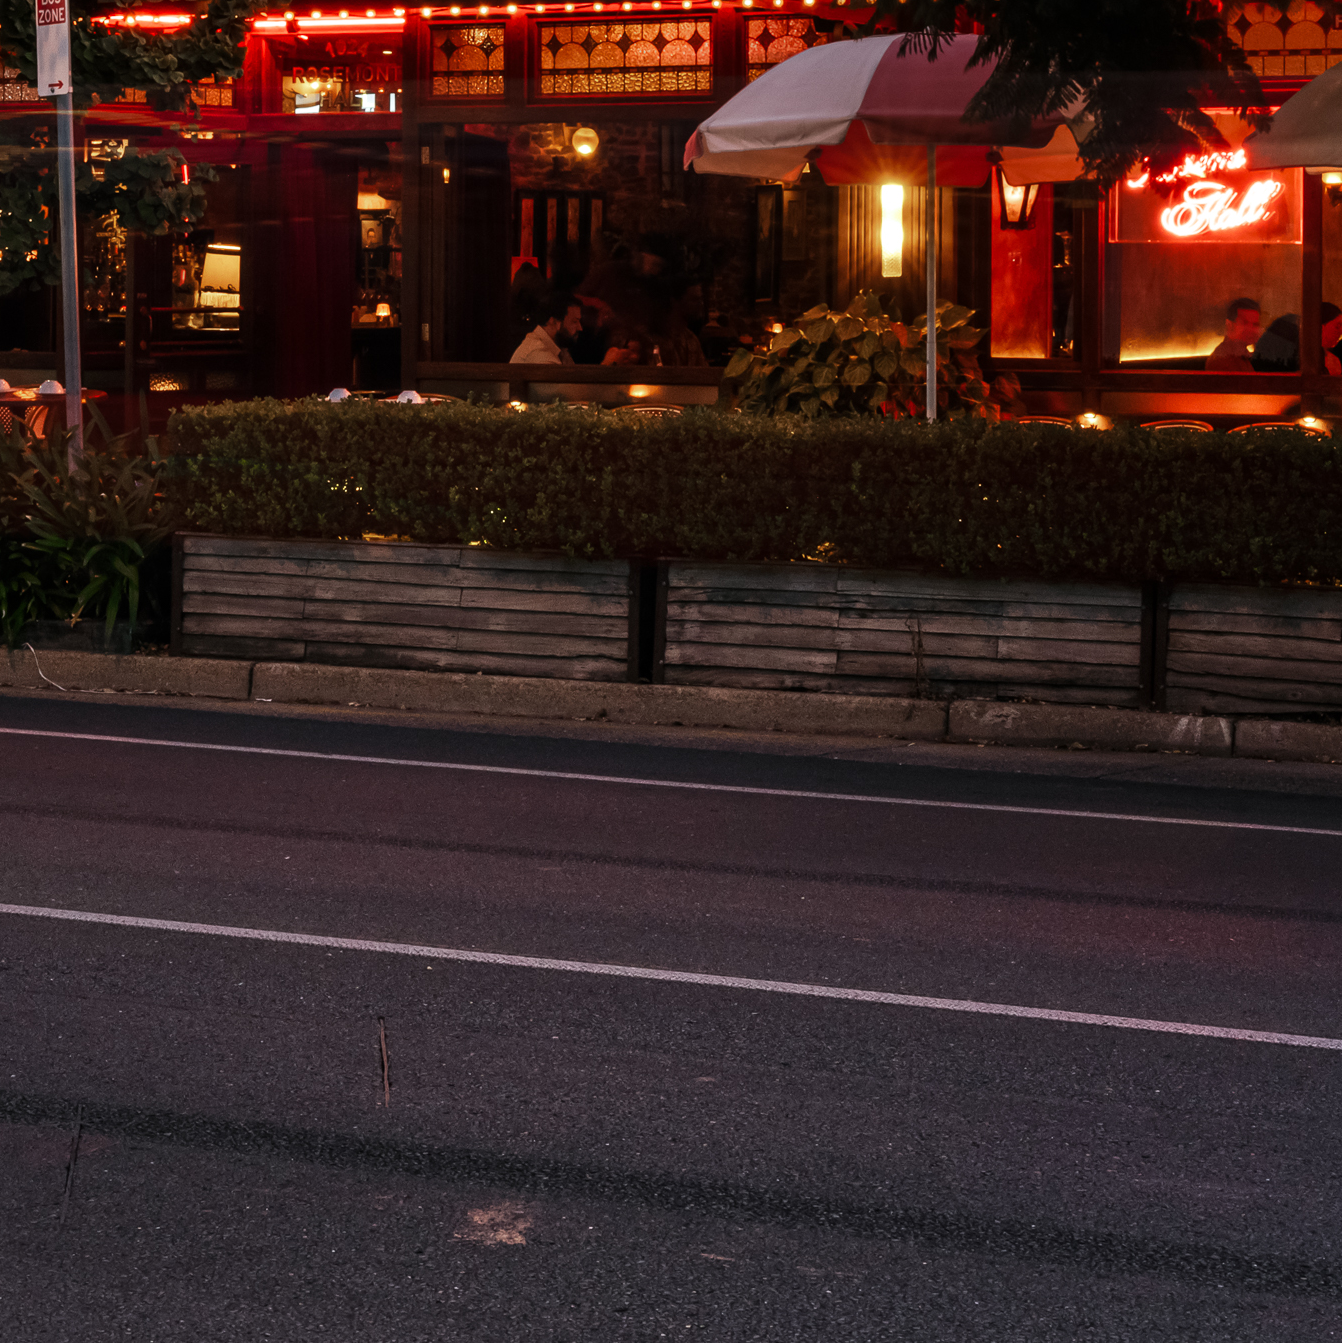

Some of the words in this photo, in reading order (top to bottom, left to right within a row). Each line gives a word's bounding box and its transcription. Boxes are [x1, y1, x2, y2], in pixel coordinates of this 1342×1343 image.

[38, 7, 65, 24] ZONE
[292, 65, 402, 84] ROSEMONT
[320, 90, 374, 108] HAL
